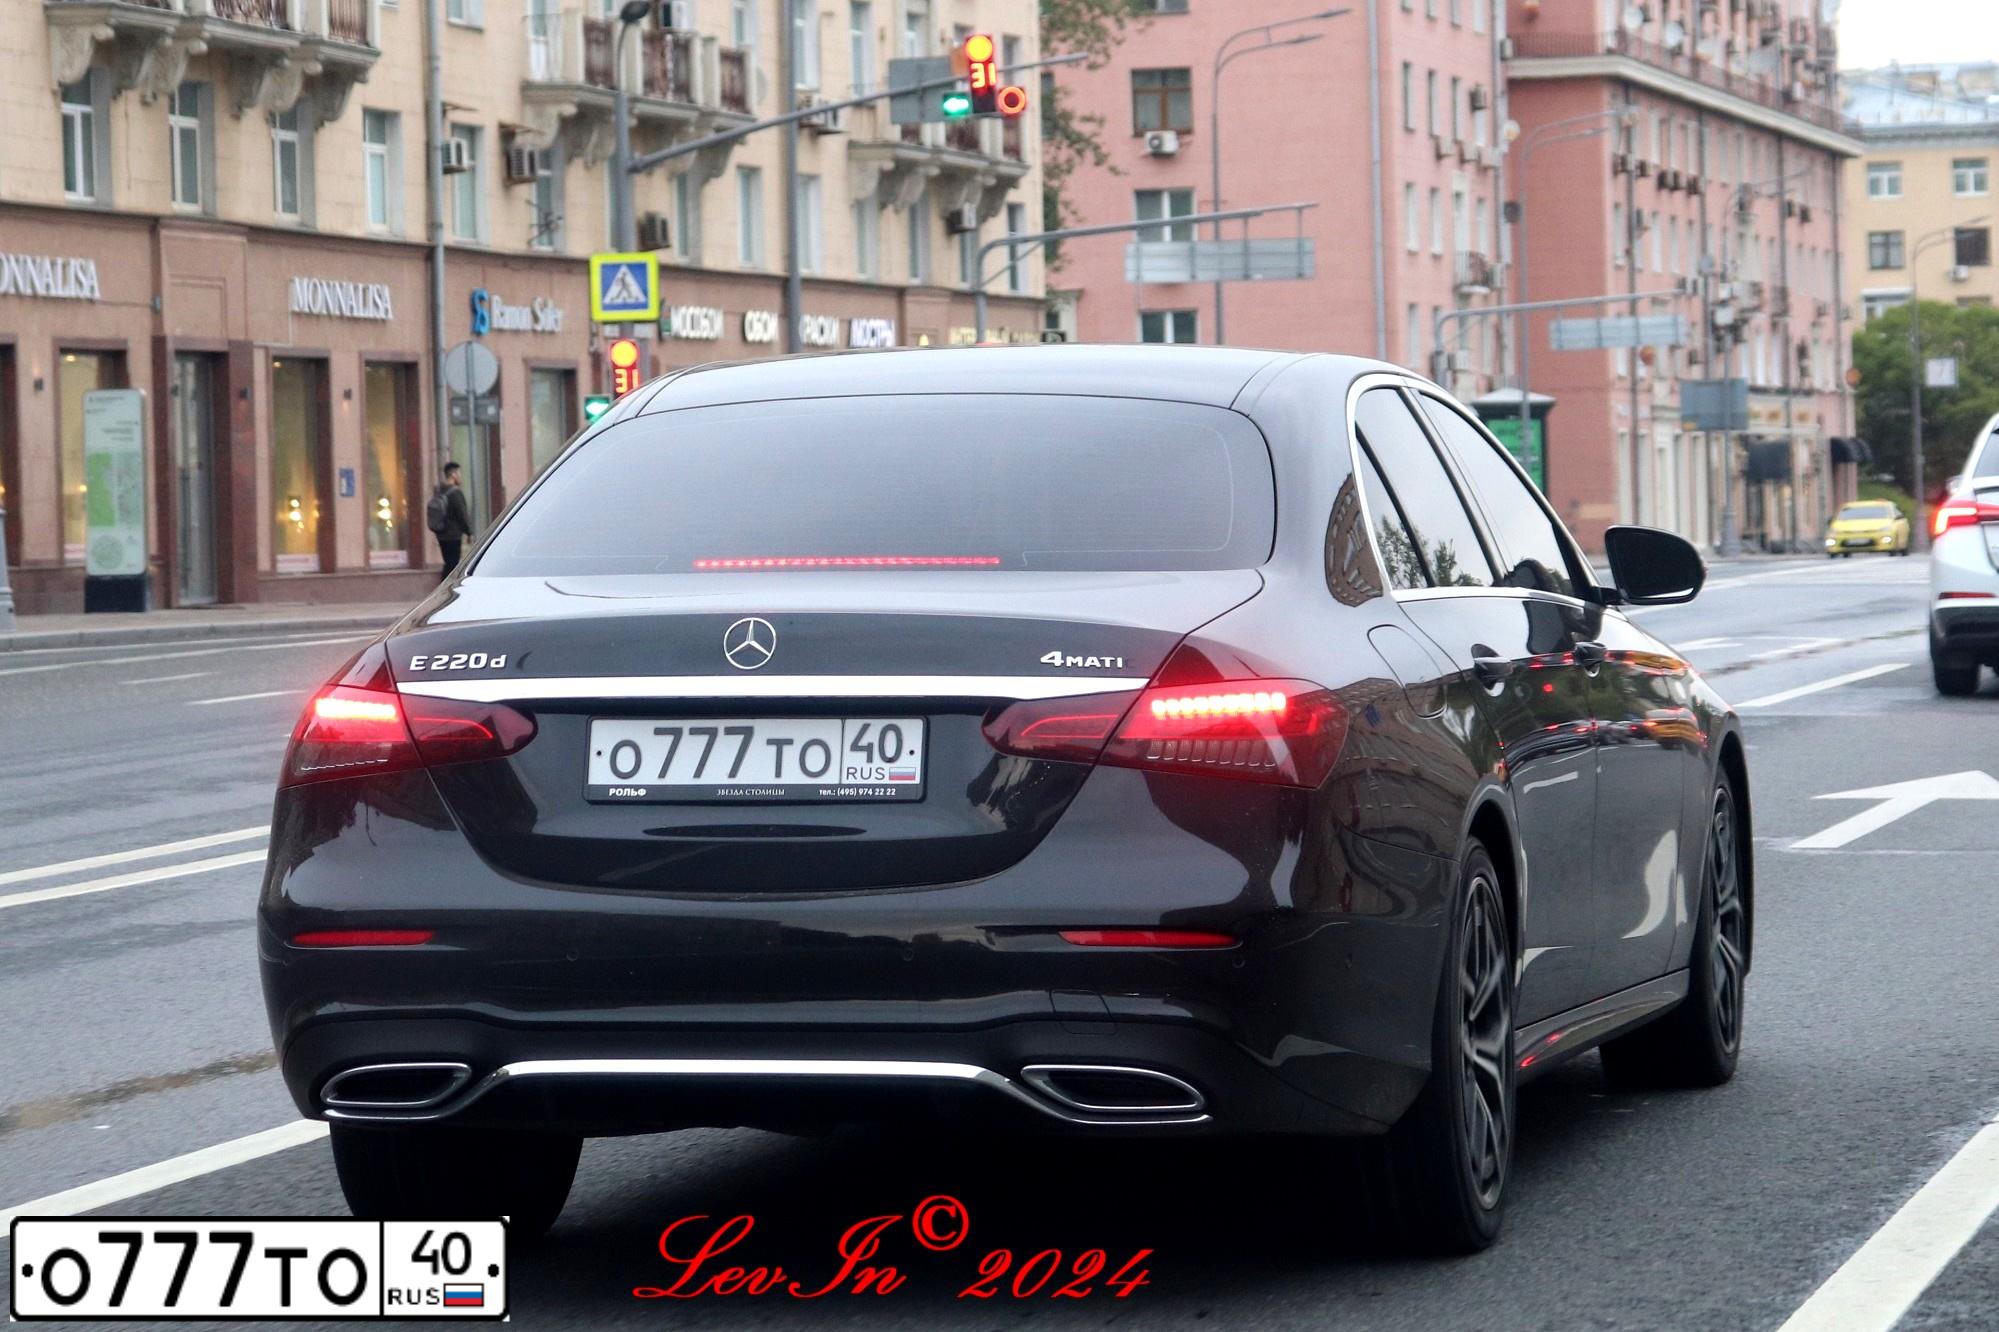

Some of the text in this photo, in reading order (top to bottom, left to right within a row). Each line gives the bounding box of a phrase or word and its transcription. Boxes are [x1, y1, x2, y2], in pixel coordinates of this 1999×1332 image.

[969, 62, 997, 89] 31
[289, 276, 393, 320] MONNALISA
[614, 368, 639, 394] 31
[849, 723, 903, 764] 40
[845, 767, 886, 781] RUS
[608, 787, 647, 797] РОЛЬФ
[716, 788, 785, 797] ЗВЕЗДА СТОЛИЦЫ
[837, 787, 857, 798] (495)
[858, 788, 874, 797] 974
[875, 788, 885, 797] 22
[886, 788, 896, 797] 22
